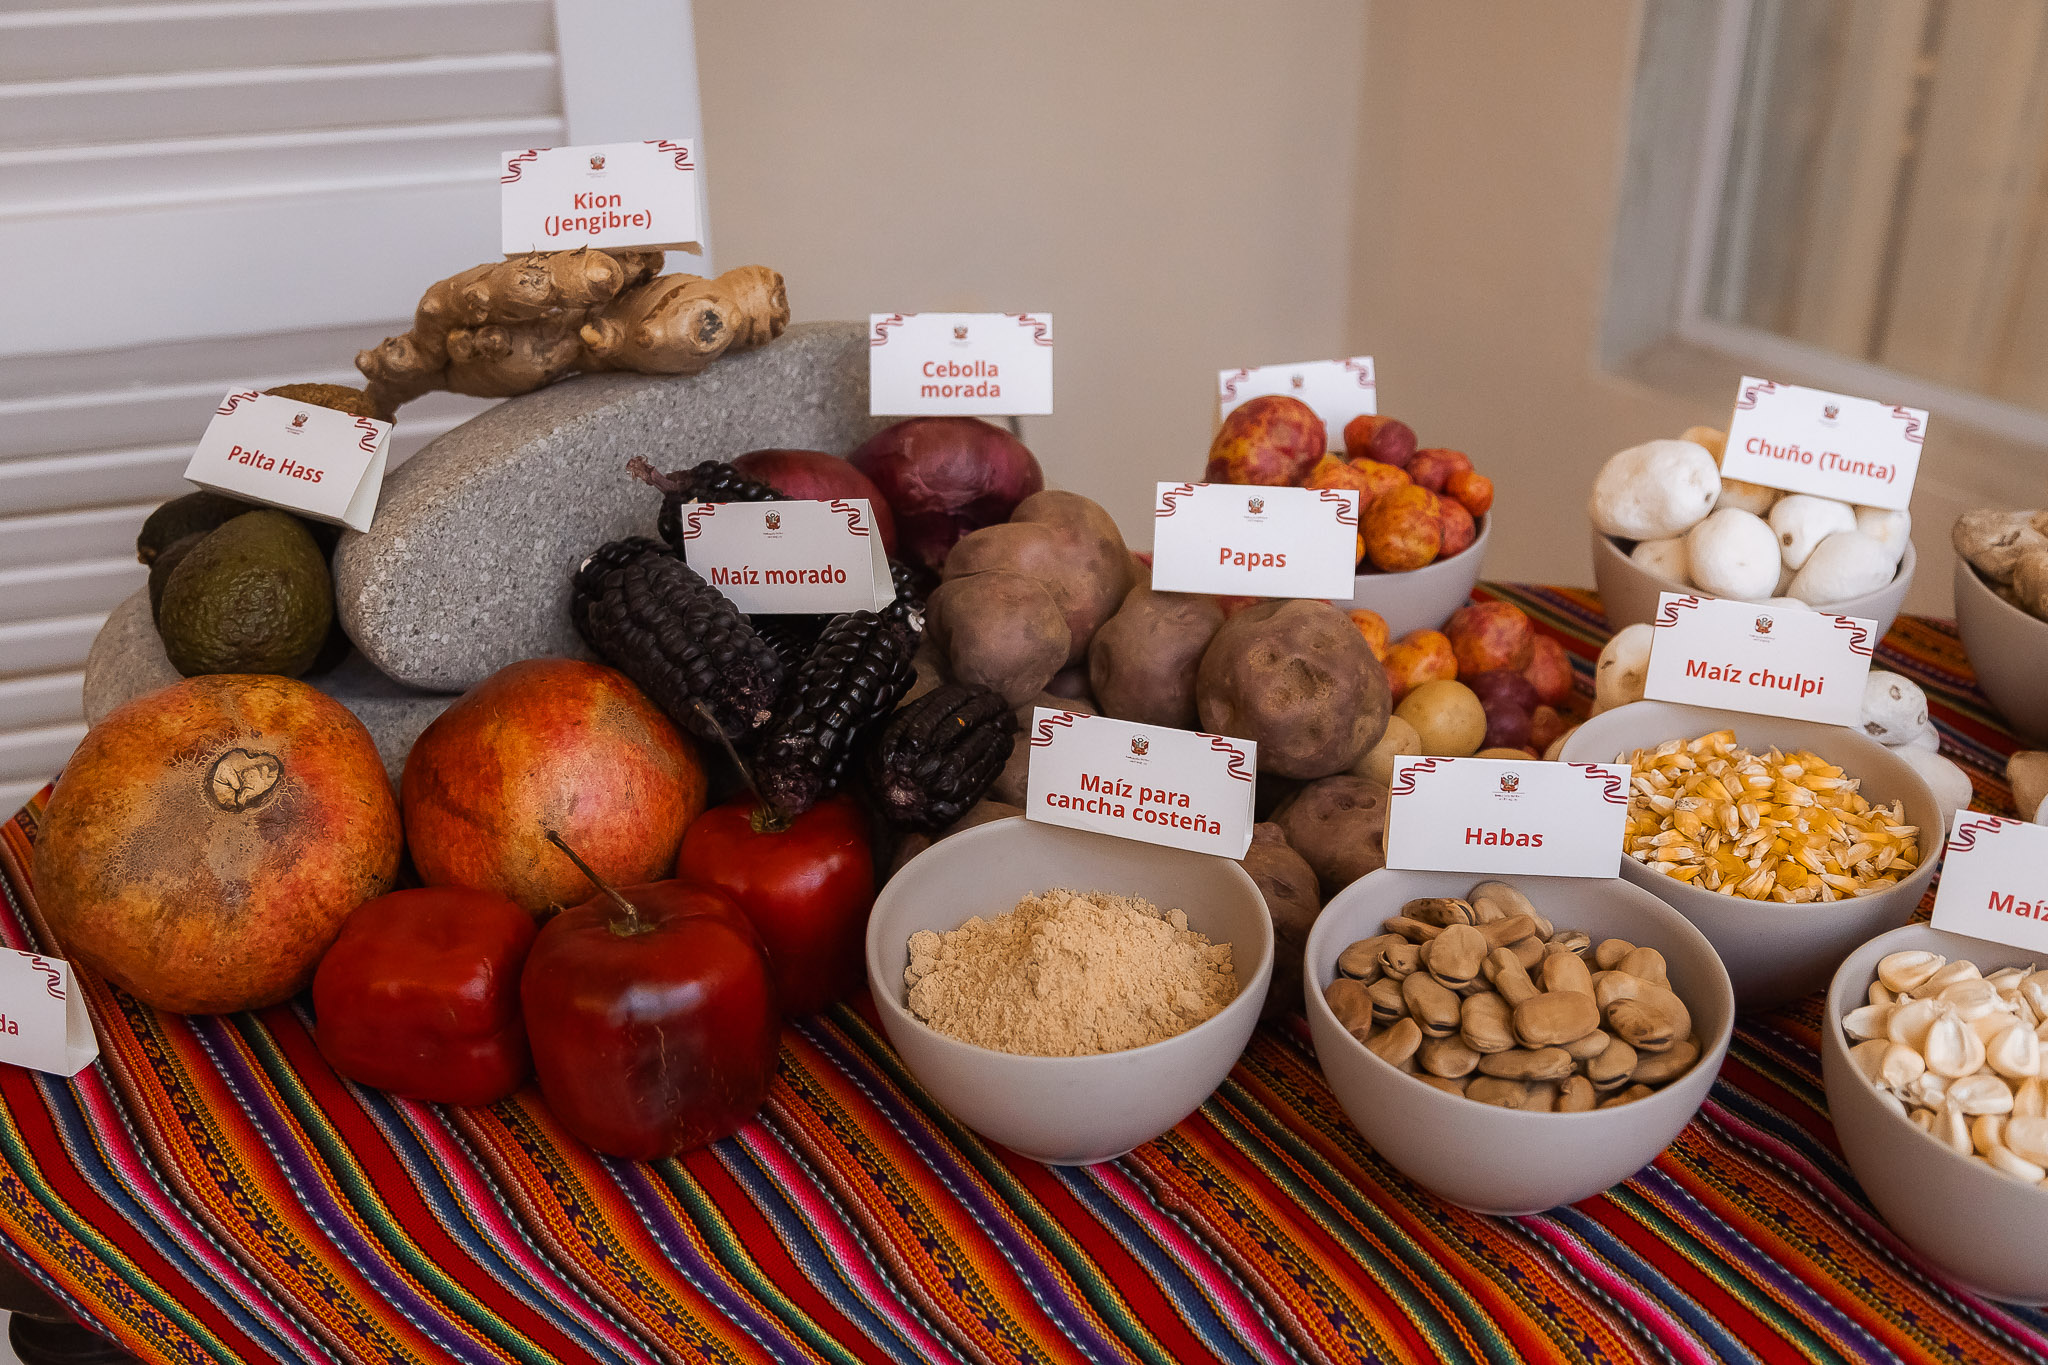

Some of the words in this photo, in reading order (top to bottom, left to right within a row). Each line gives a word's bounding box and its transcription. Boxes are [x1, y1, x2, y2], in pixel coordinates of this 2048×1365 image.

[574, 192, 622, 211] Kion
[545, 210, 652, 238] (Jengibre)
[922, 361, 998, 378] Cebolla
[922, 381, 1001, 398] morada
[227, 445, 276, 472] Palta
[278, 457, 325, 484] Hass
[1747, 437, 1814, 465] Chuño
[1819, 452, 1896, 483] (Tunta)
[1219, 547, 1287, 572] Papas
[710, 565, 760, 585] Maíz
[764, 564, 847, 585] morado
[1686, 659, 1743, 684] Maíz
[1748, 669, 1825, 699] chulpi
[1081, 773, 1133, 799] Maíz
[1138, 786, 1191, 809] para
[1046, 792, 1126, 819] cancha
[1132, 804, 1221, 836] costeña
[1465, 827, 1543, 848] Habas
